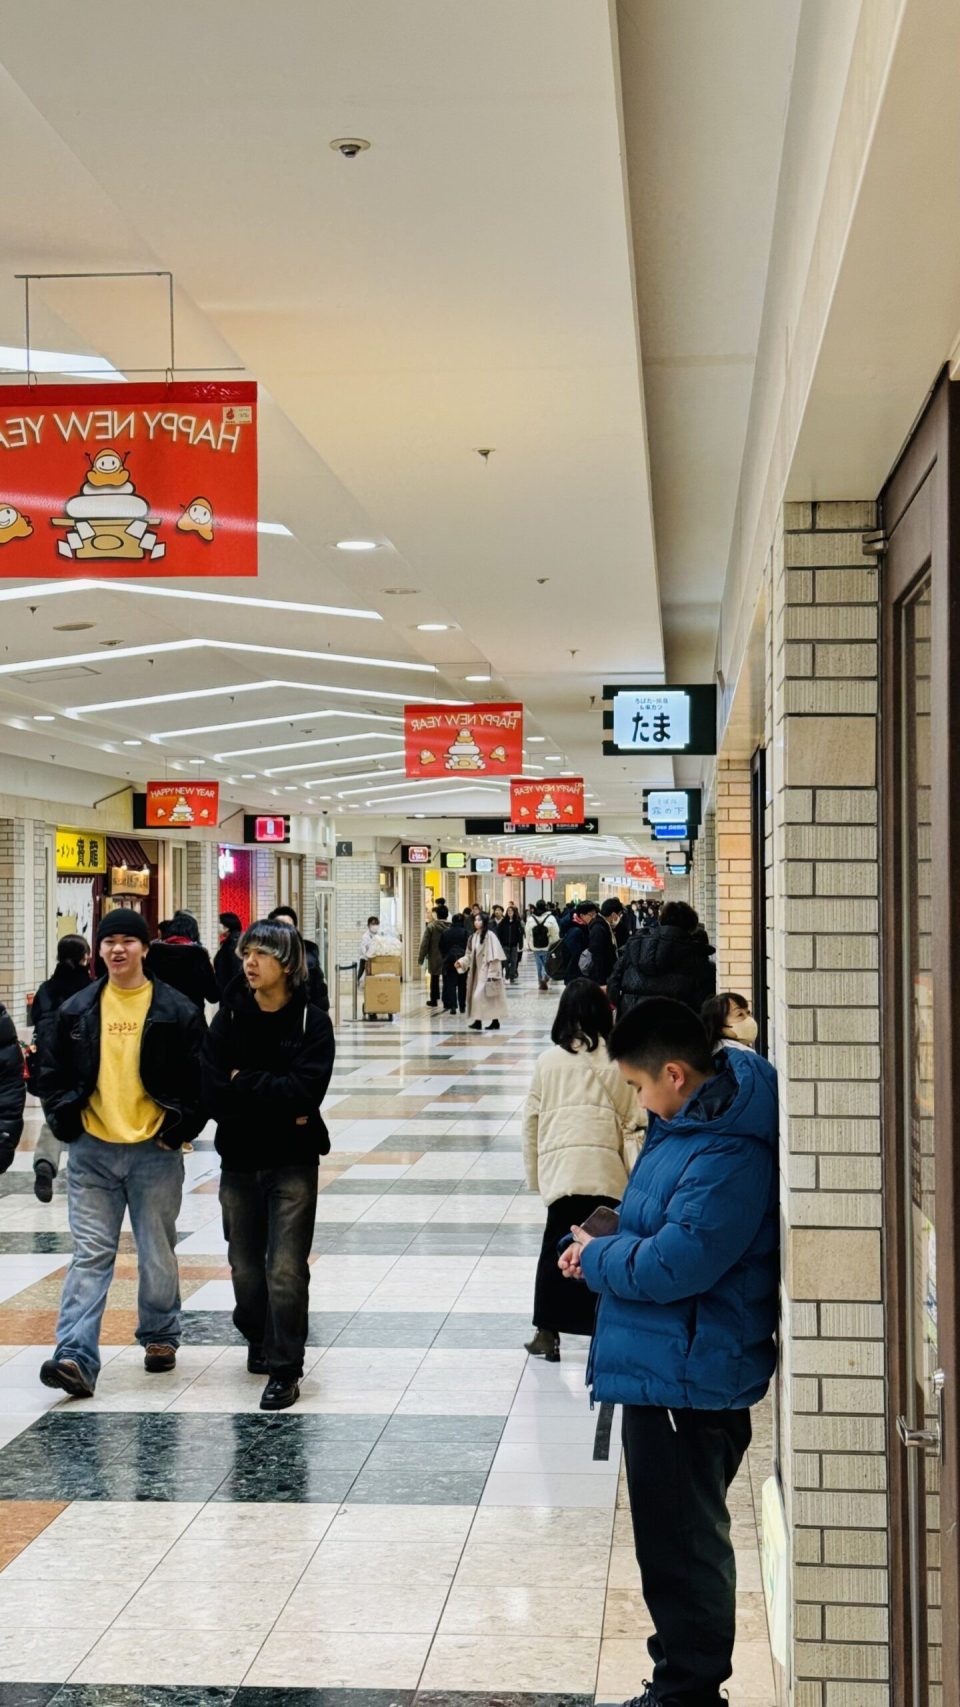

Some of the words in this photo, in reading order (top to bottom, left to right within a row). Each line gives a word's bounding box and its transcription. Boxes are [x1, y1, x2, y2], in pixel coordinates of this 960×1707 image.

[632, 712, 671, 743] たま
[150, 788, 175, 799] HAPPY
[175, 786, 195, 795] NEW
[195, 787, 215, 798] YEAR
